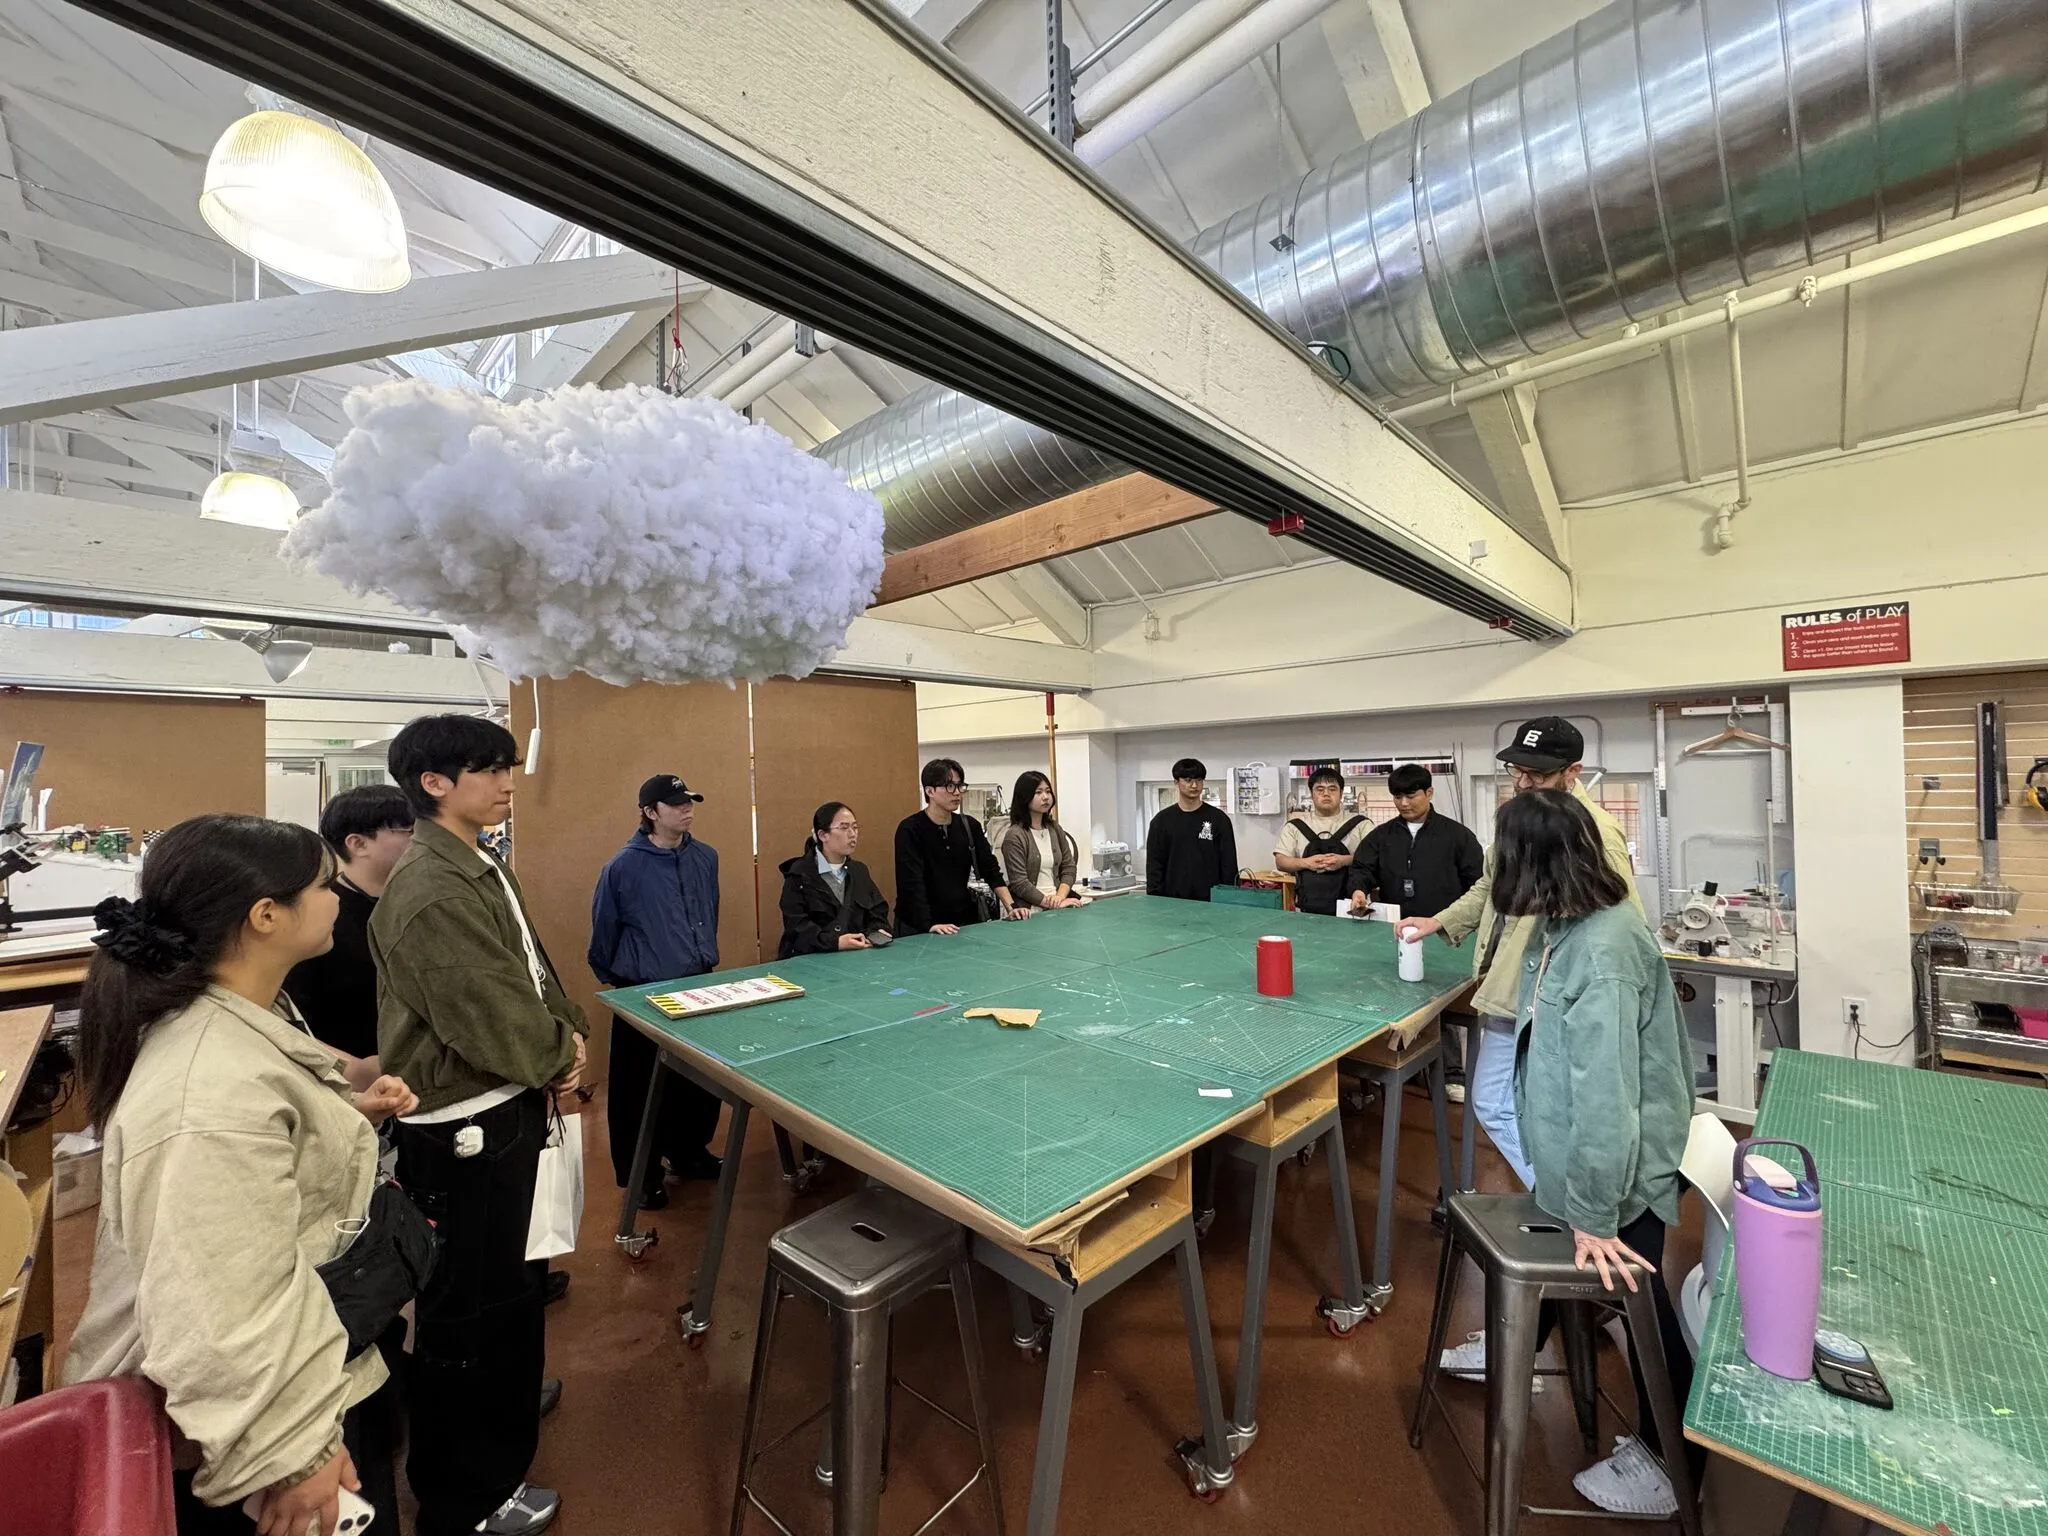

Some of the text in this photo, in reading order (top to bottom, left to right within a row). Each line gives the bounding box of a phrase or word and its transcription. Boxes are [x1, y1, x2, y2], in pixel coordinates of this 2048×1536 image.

[1785, 605, 1904, 628] RULES of PLAY
